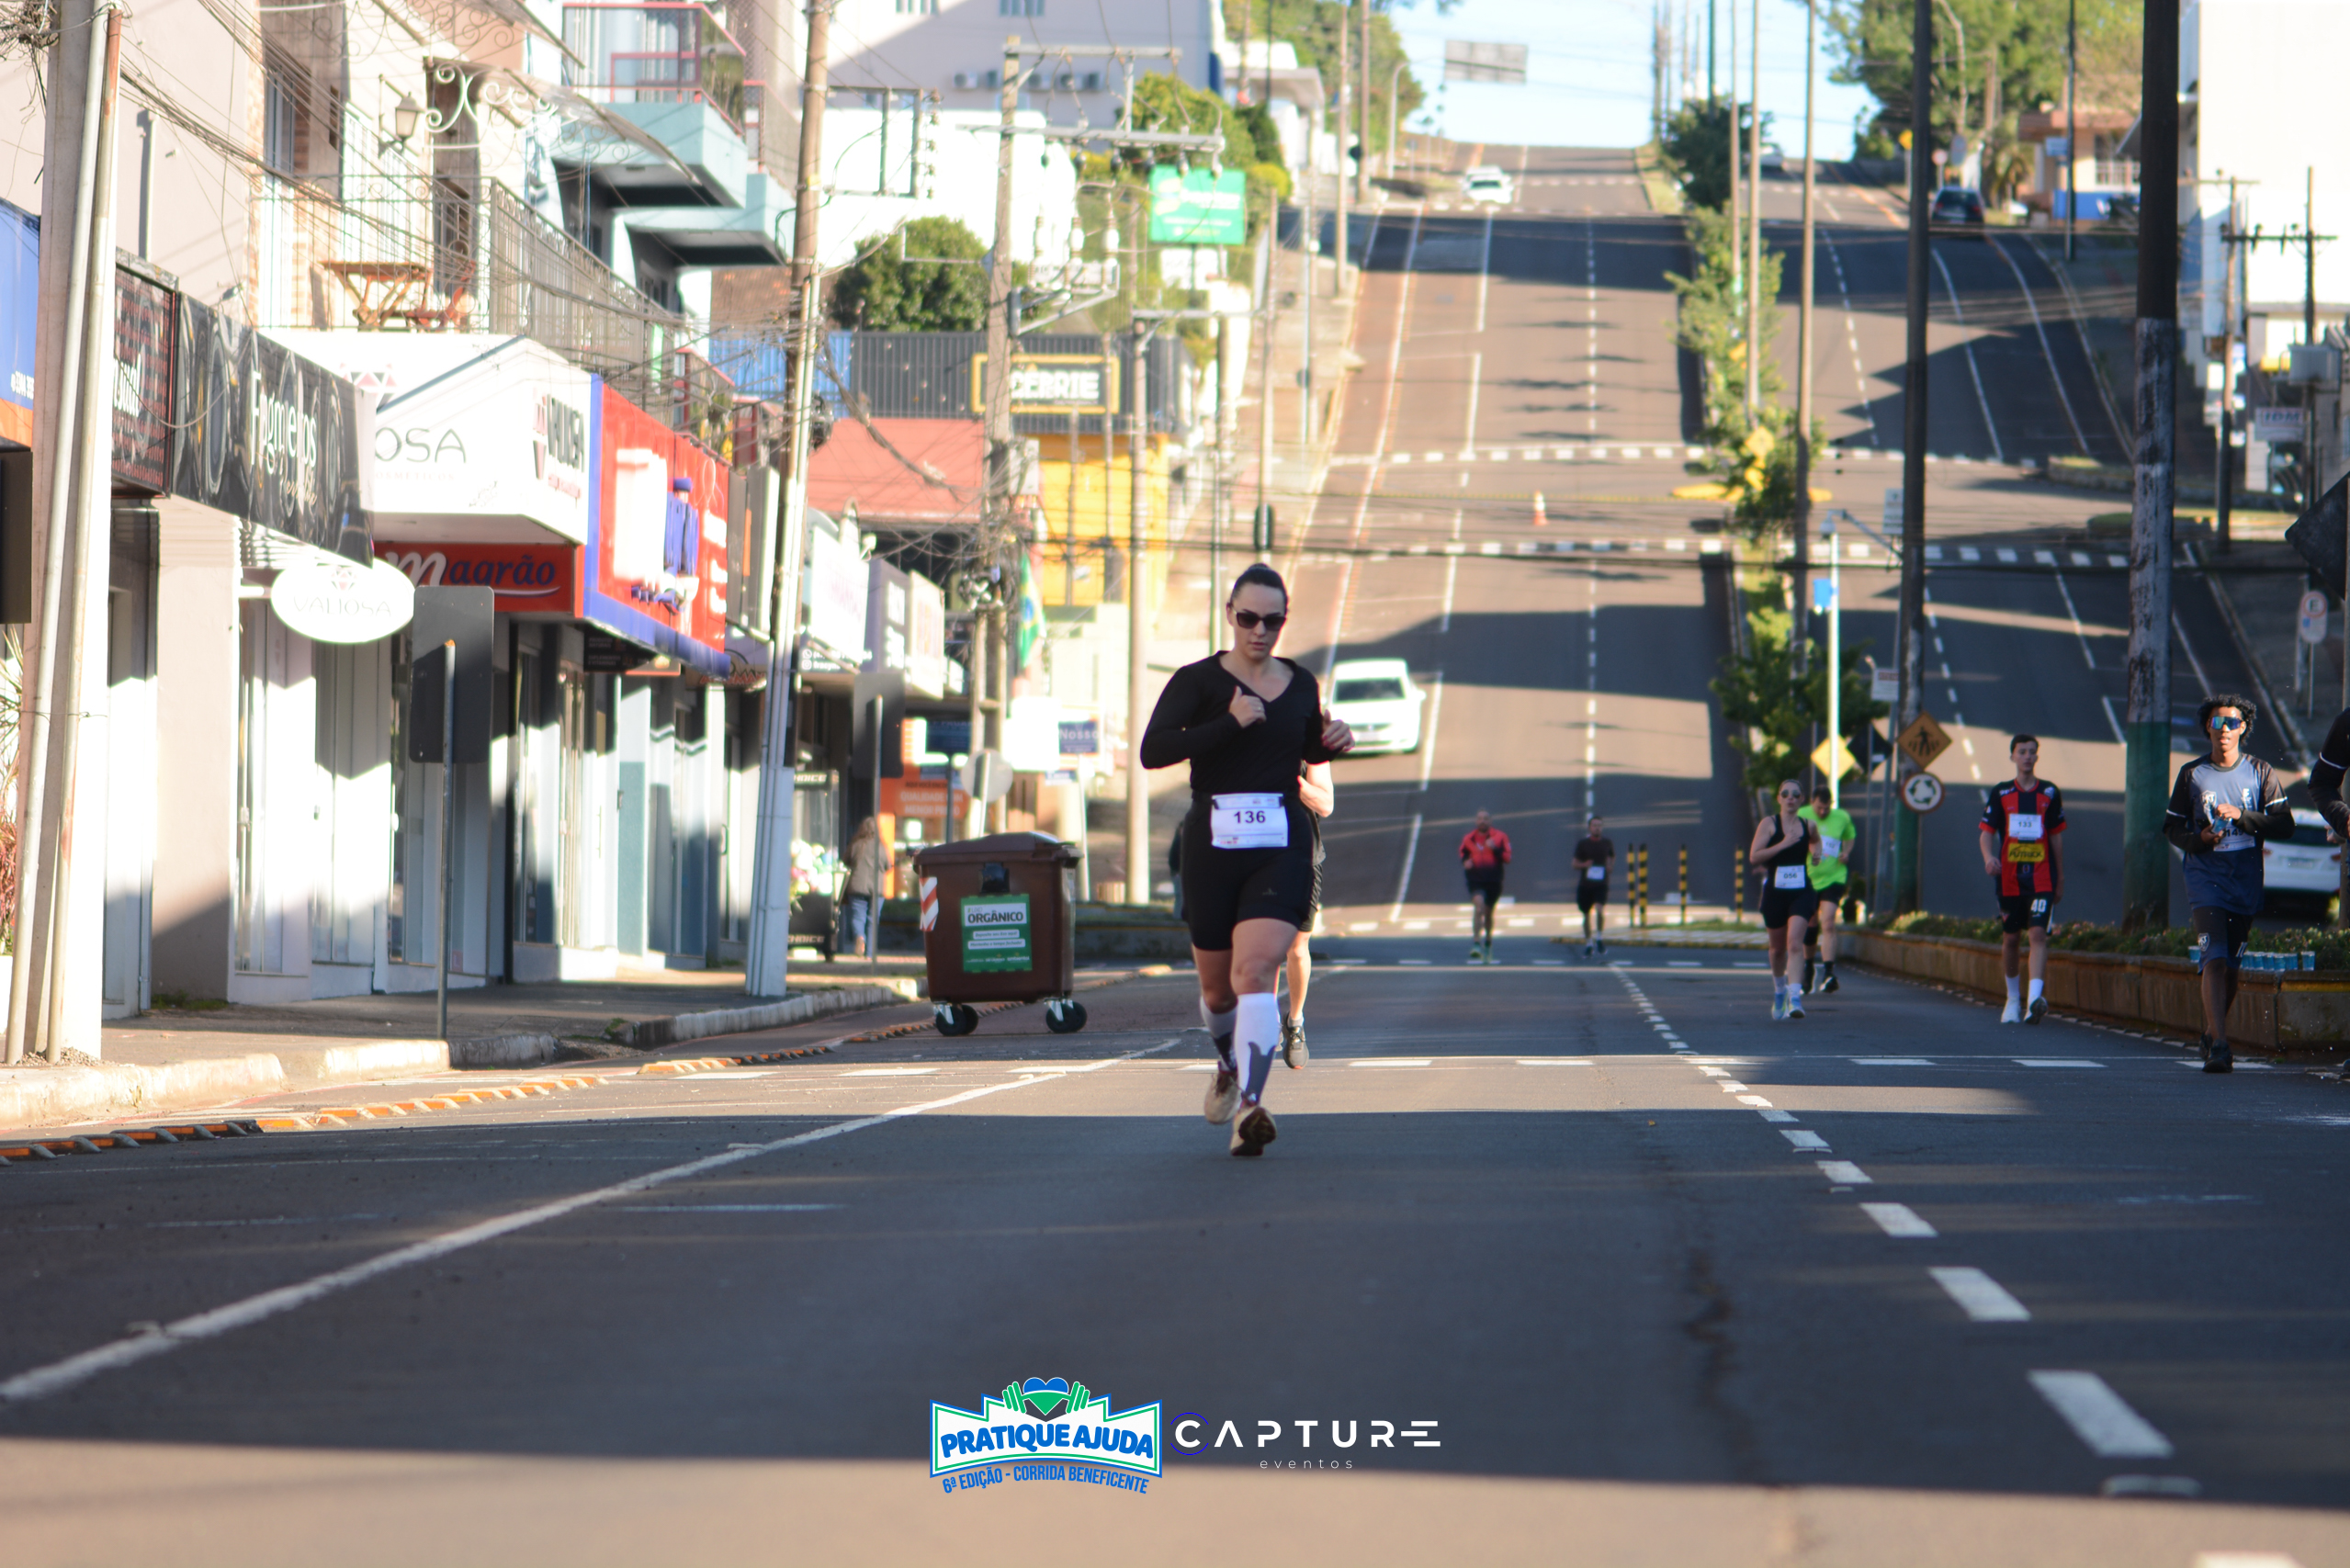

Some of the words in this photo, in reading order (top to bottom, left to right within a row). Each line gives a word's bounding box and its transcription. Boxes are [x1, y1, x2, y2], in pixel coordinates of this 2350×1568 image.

[293, 596, 391, 616] VALIOSA
[1234, 810, 1266, 823] 136
[2030, 899, 2047, 912] 40
[968, 910, 1023, 923] ORGÂNICO
